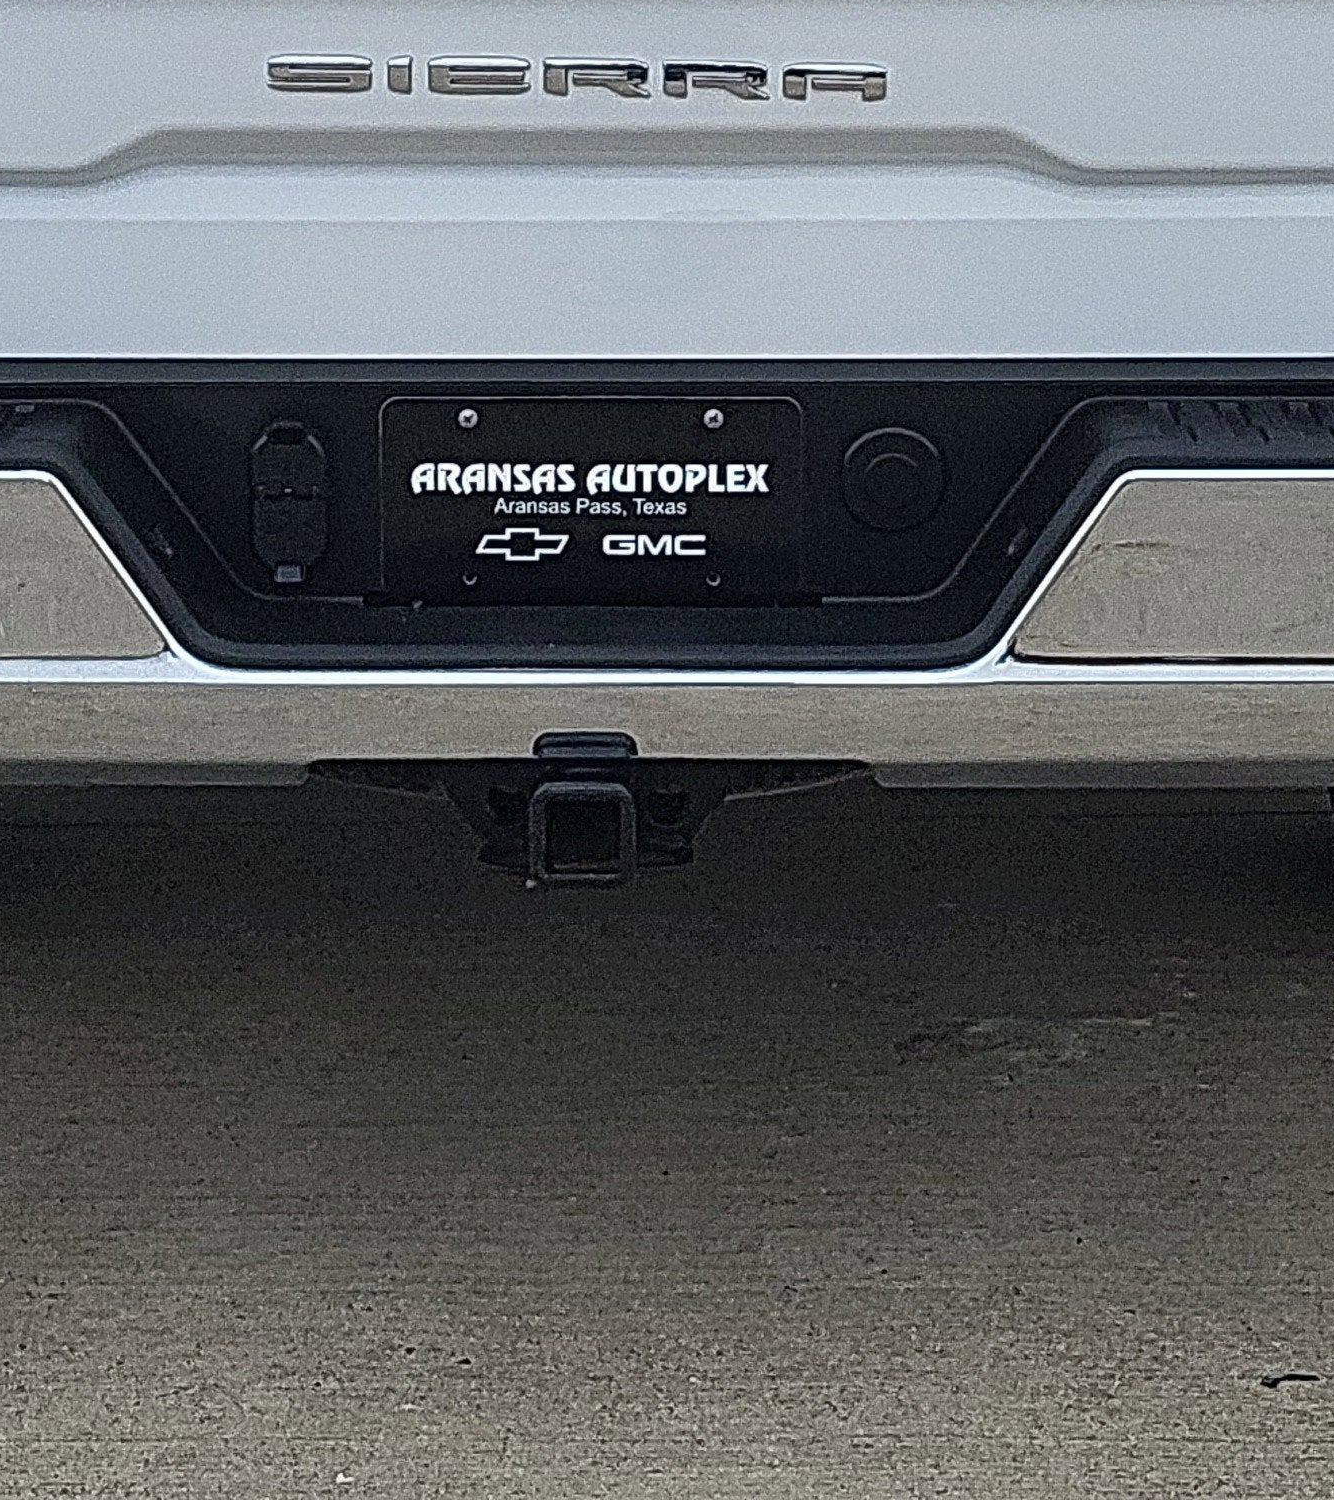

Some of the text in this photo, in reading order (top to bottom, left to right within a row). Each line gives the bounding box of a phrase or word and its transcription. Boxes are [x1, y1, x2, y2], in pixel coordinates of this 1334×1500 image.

[265, 53, 889, 102] SIERRA
[410, 463, 770, 495] ARANSAS AUTOPLEX
[494, 498, 687, 517] Aransas Pass, Texas
[602, 534, 707, 556] GMC
